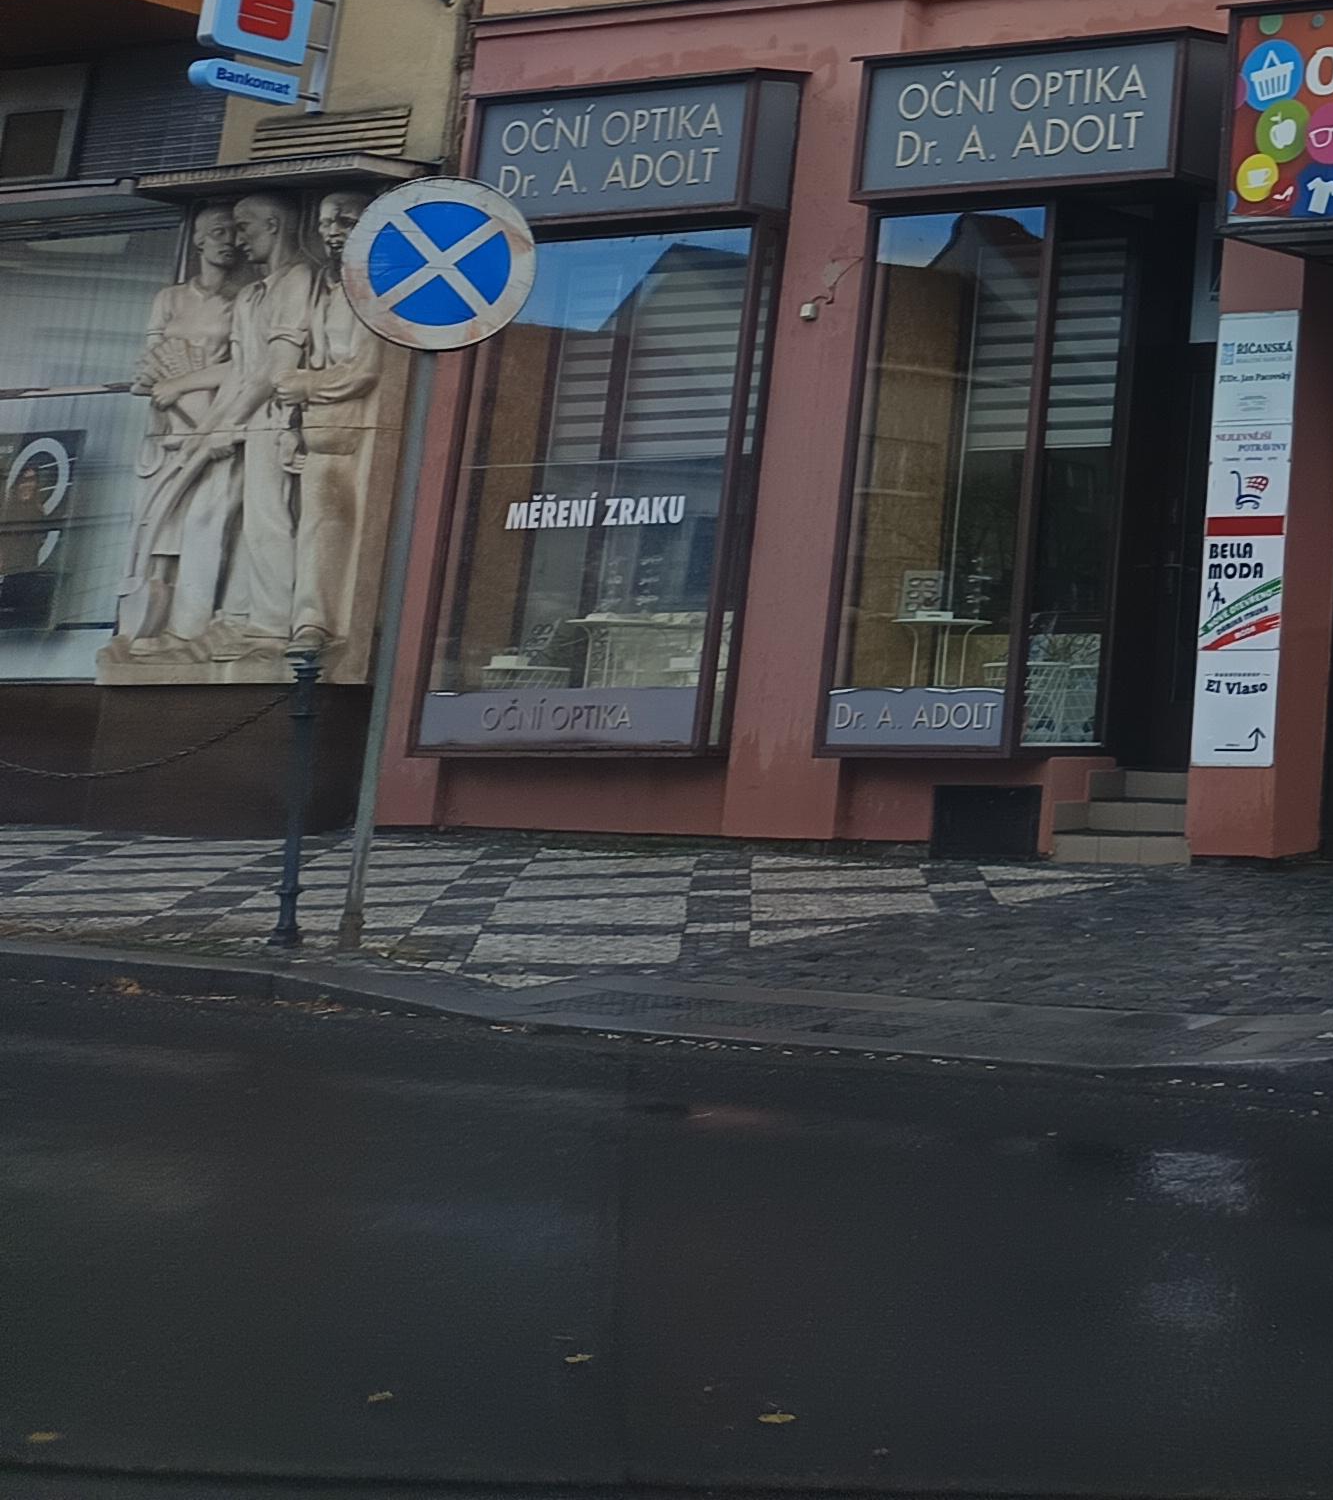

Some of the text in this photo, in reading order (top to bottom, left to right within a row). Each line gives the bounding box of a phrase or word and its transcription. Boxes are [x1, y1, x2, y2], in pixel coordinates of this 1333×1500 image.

[216, 67, 291, 96] Bankomat
[898, 64, 1147, 120] OČNÍ OPTIKA
[502, 103, 723, 155] OČNÍ OPTIKA
[895, 111, 1144, 168] Dr. A. ADOLT
[499, 147, 720, 198] Dr. A. ADOLT
[505, 492, 686, 530] MĚŘENÍ ZRAKU
[1208, 542, 1253, 559] BELLA
[1208, 562, 1263, 579] MODA
[1205, 679, 1268, 695] El Vlaso
[482, 698, 632, 731] OČNÍ OPTIKA
[834, 702, 997, 730] Dr. A. ADOLT
